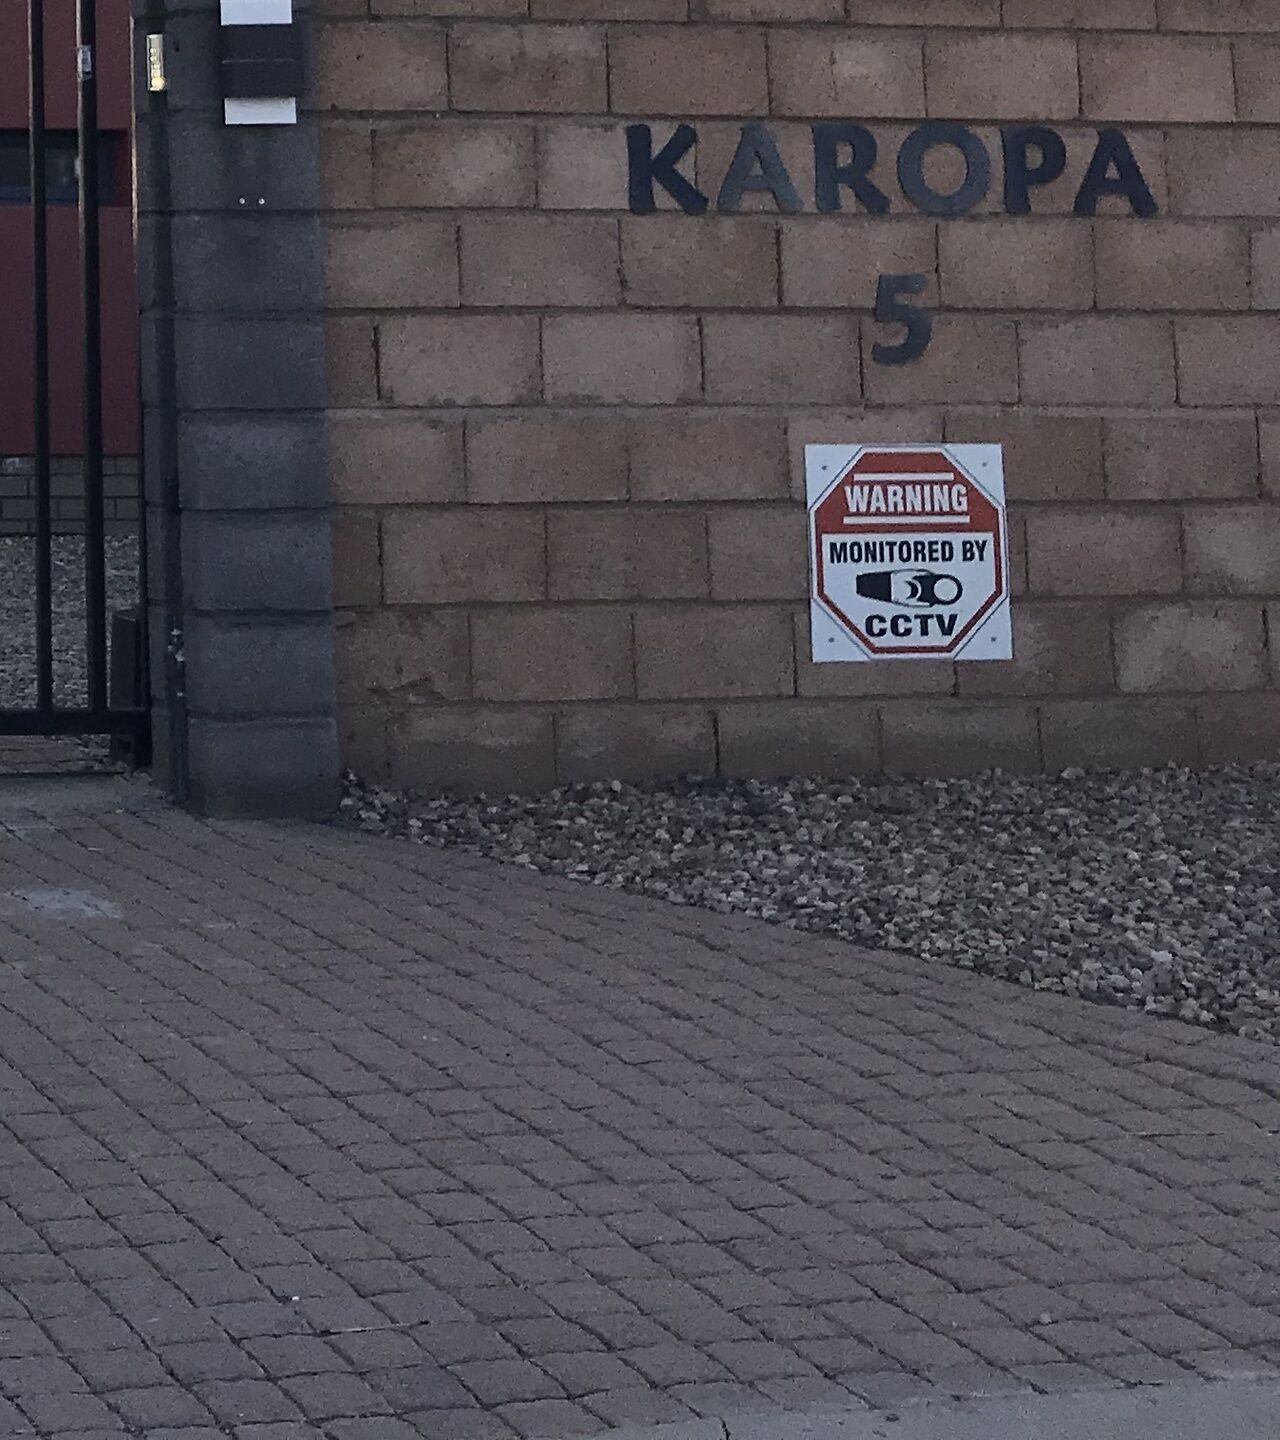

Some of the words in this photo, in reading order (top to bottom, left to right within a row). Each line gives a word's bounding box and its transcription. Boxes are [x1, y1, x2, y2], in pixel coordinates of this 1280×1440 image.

[625, 122, 1159, 218] KAROPA
[871, 273, 934, 365] 5
[844, 483, 968, 513] WARNING
[829, 540, 955, 564] MONITORED
[961, 539, 988, 562] BY
[864, 613, 958, 638] CCTV
